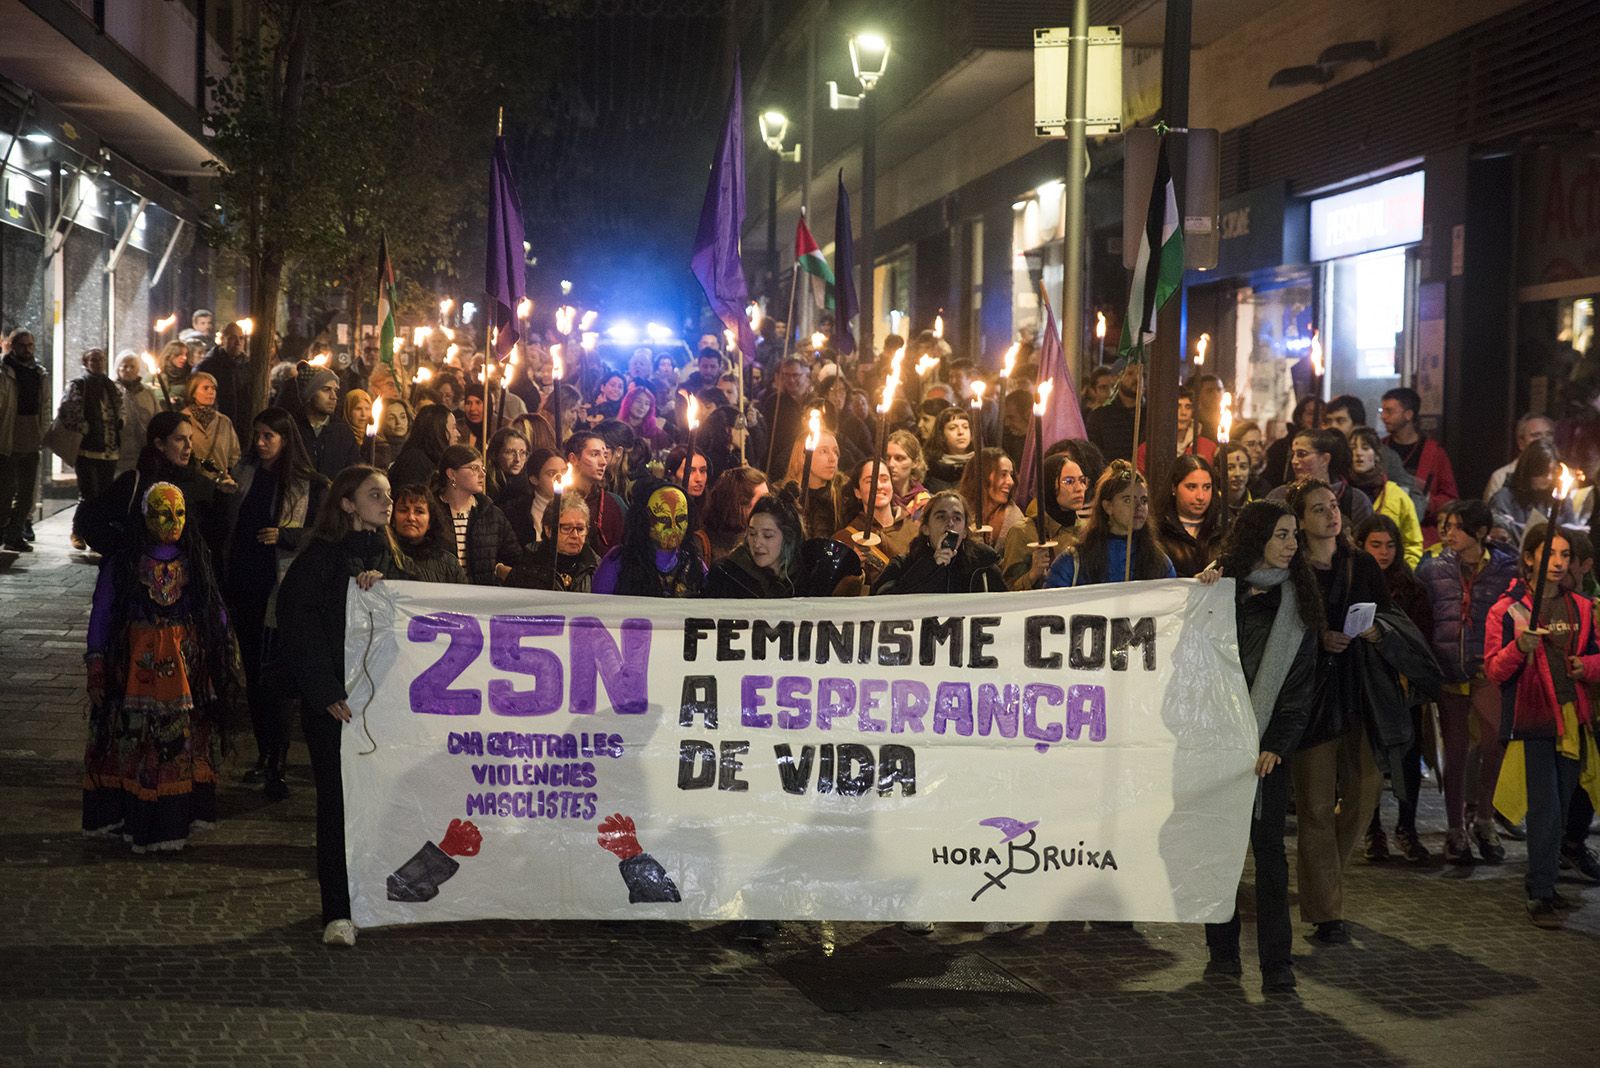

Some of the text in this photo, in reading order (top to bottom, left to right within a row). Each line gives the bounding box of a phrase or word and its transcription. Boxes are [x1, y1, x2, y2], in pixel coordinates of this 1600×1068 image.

[407, 611, 653, 717] 25N
[683, 614, 1157, 671] FEMINISME COM
[679, 675, 1106, 753] A ESPERANÇA
[447, 731, 625, 759] DIA CONTRA LES
[471, 759, 597, 788] VIOLÈNCIES
[677, 739, 916, 797] DE VIDA
[466, 790, 598, 820] MASCLISTES
[932, 846, 1001, 865] HORA
